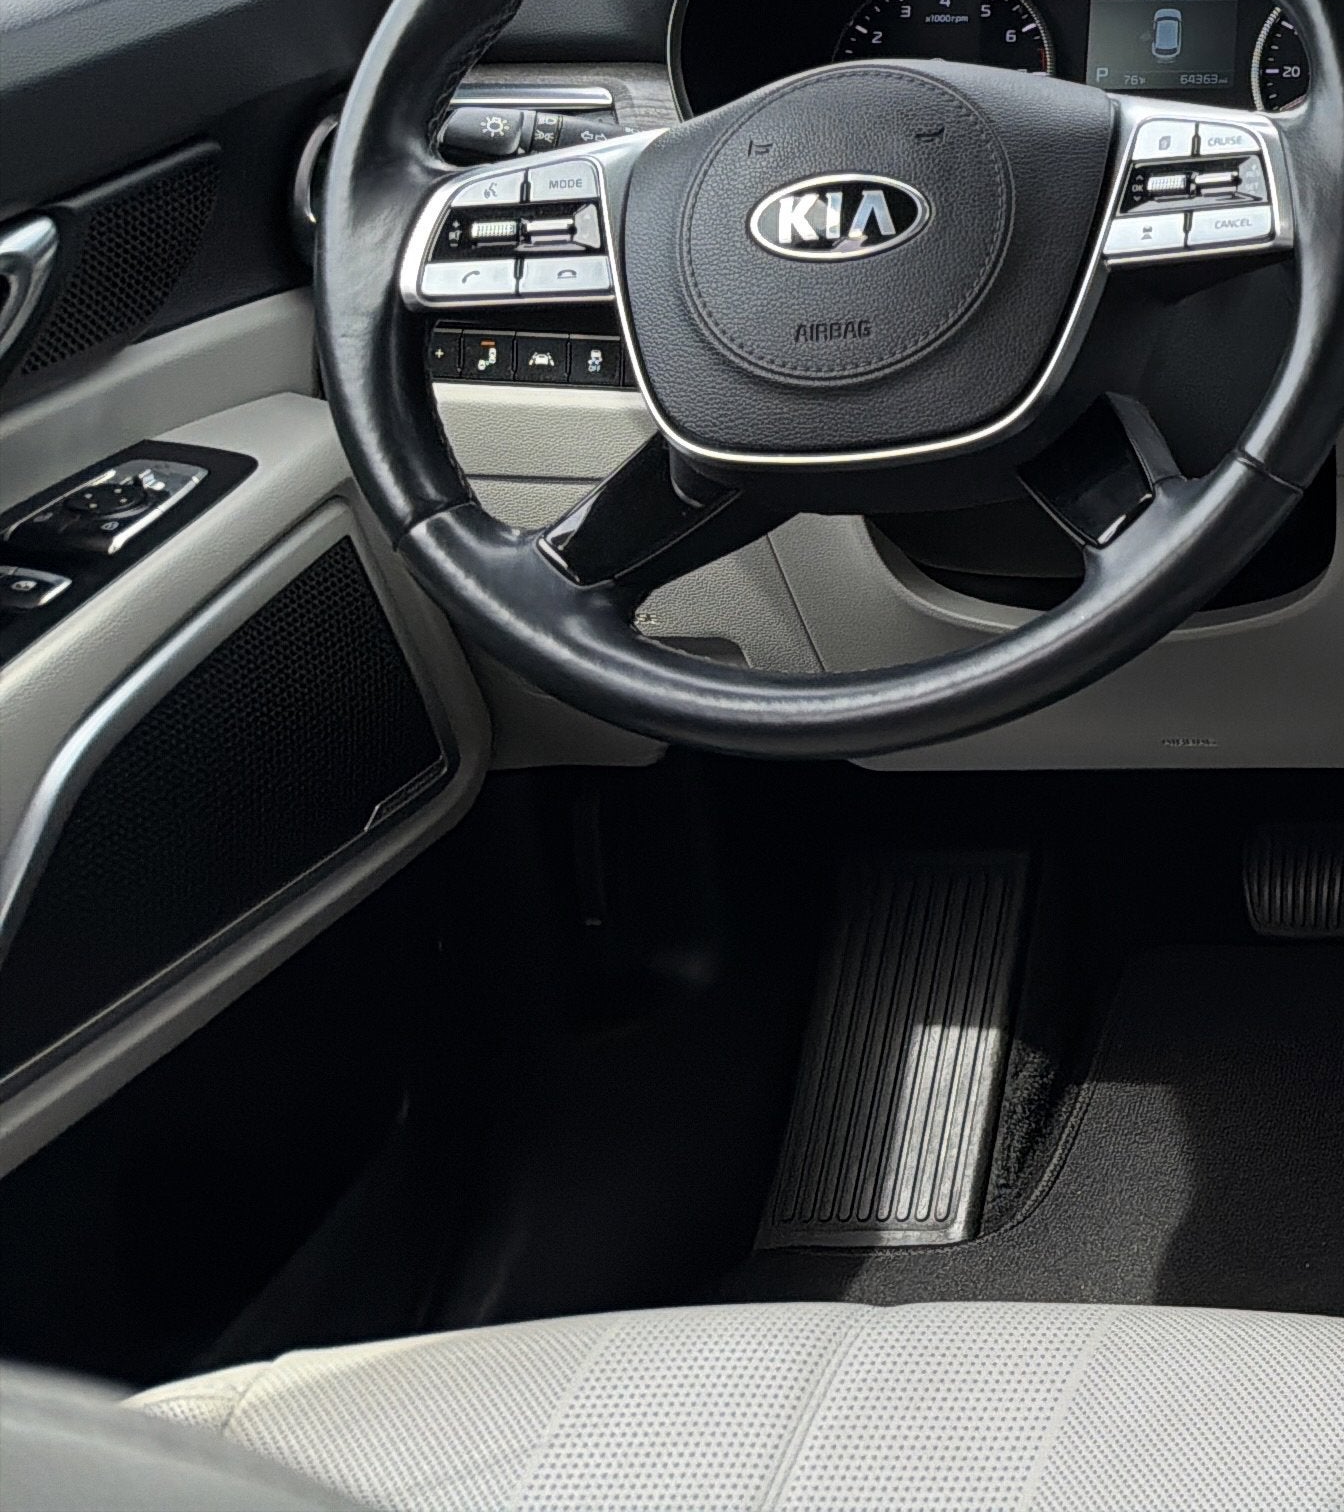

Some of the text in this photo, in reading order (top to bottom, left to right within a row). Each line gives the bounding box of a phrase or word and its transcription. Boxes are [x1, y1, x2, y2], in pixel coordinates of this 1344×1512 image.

[900, 5, 911, 18] 3
[980, 4, 991, 17] 5
[871, 31, 882, 44] 2
[1005, 29, 1017, 43] 6
[1096, 67, 1109, 83] P
[1282, 66, 1301, 78] 20
[1207, 135, 1243, 148] CRUISE
[549, 177, 583, 190] MODE
[1131, 183, 1144, 193] OK
[778, 189, 897, 244] KIA
[1214, 218, 1253, 230] CANCEL
[794, 319, 873, 343] AIRBAG
